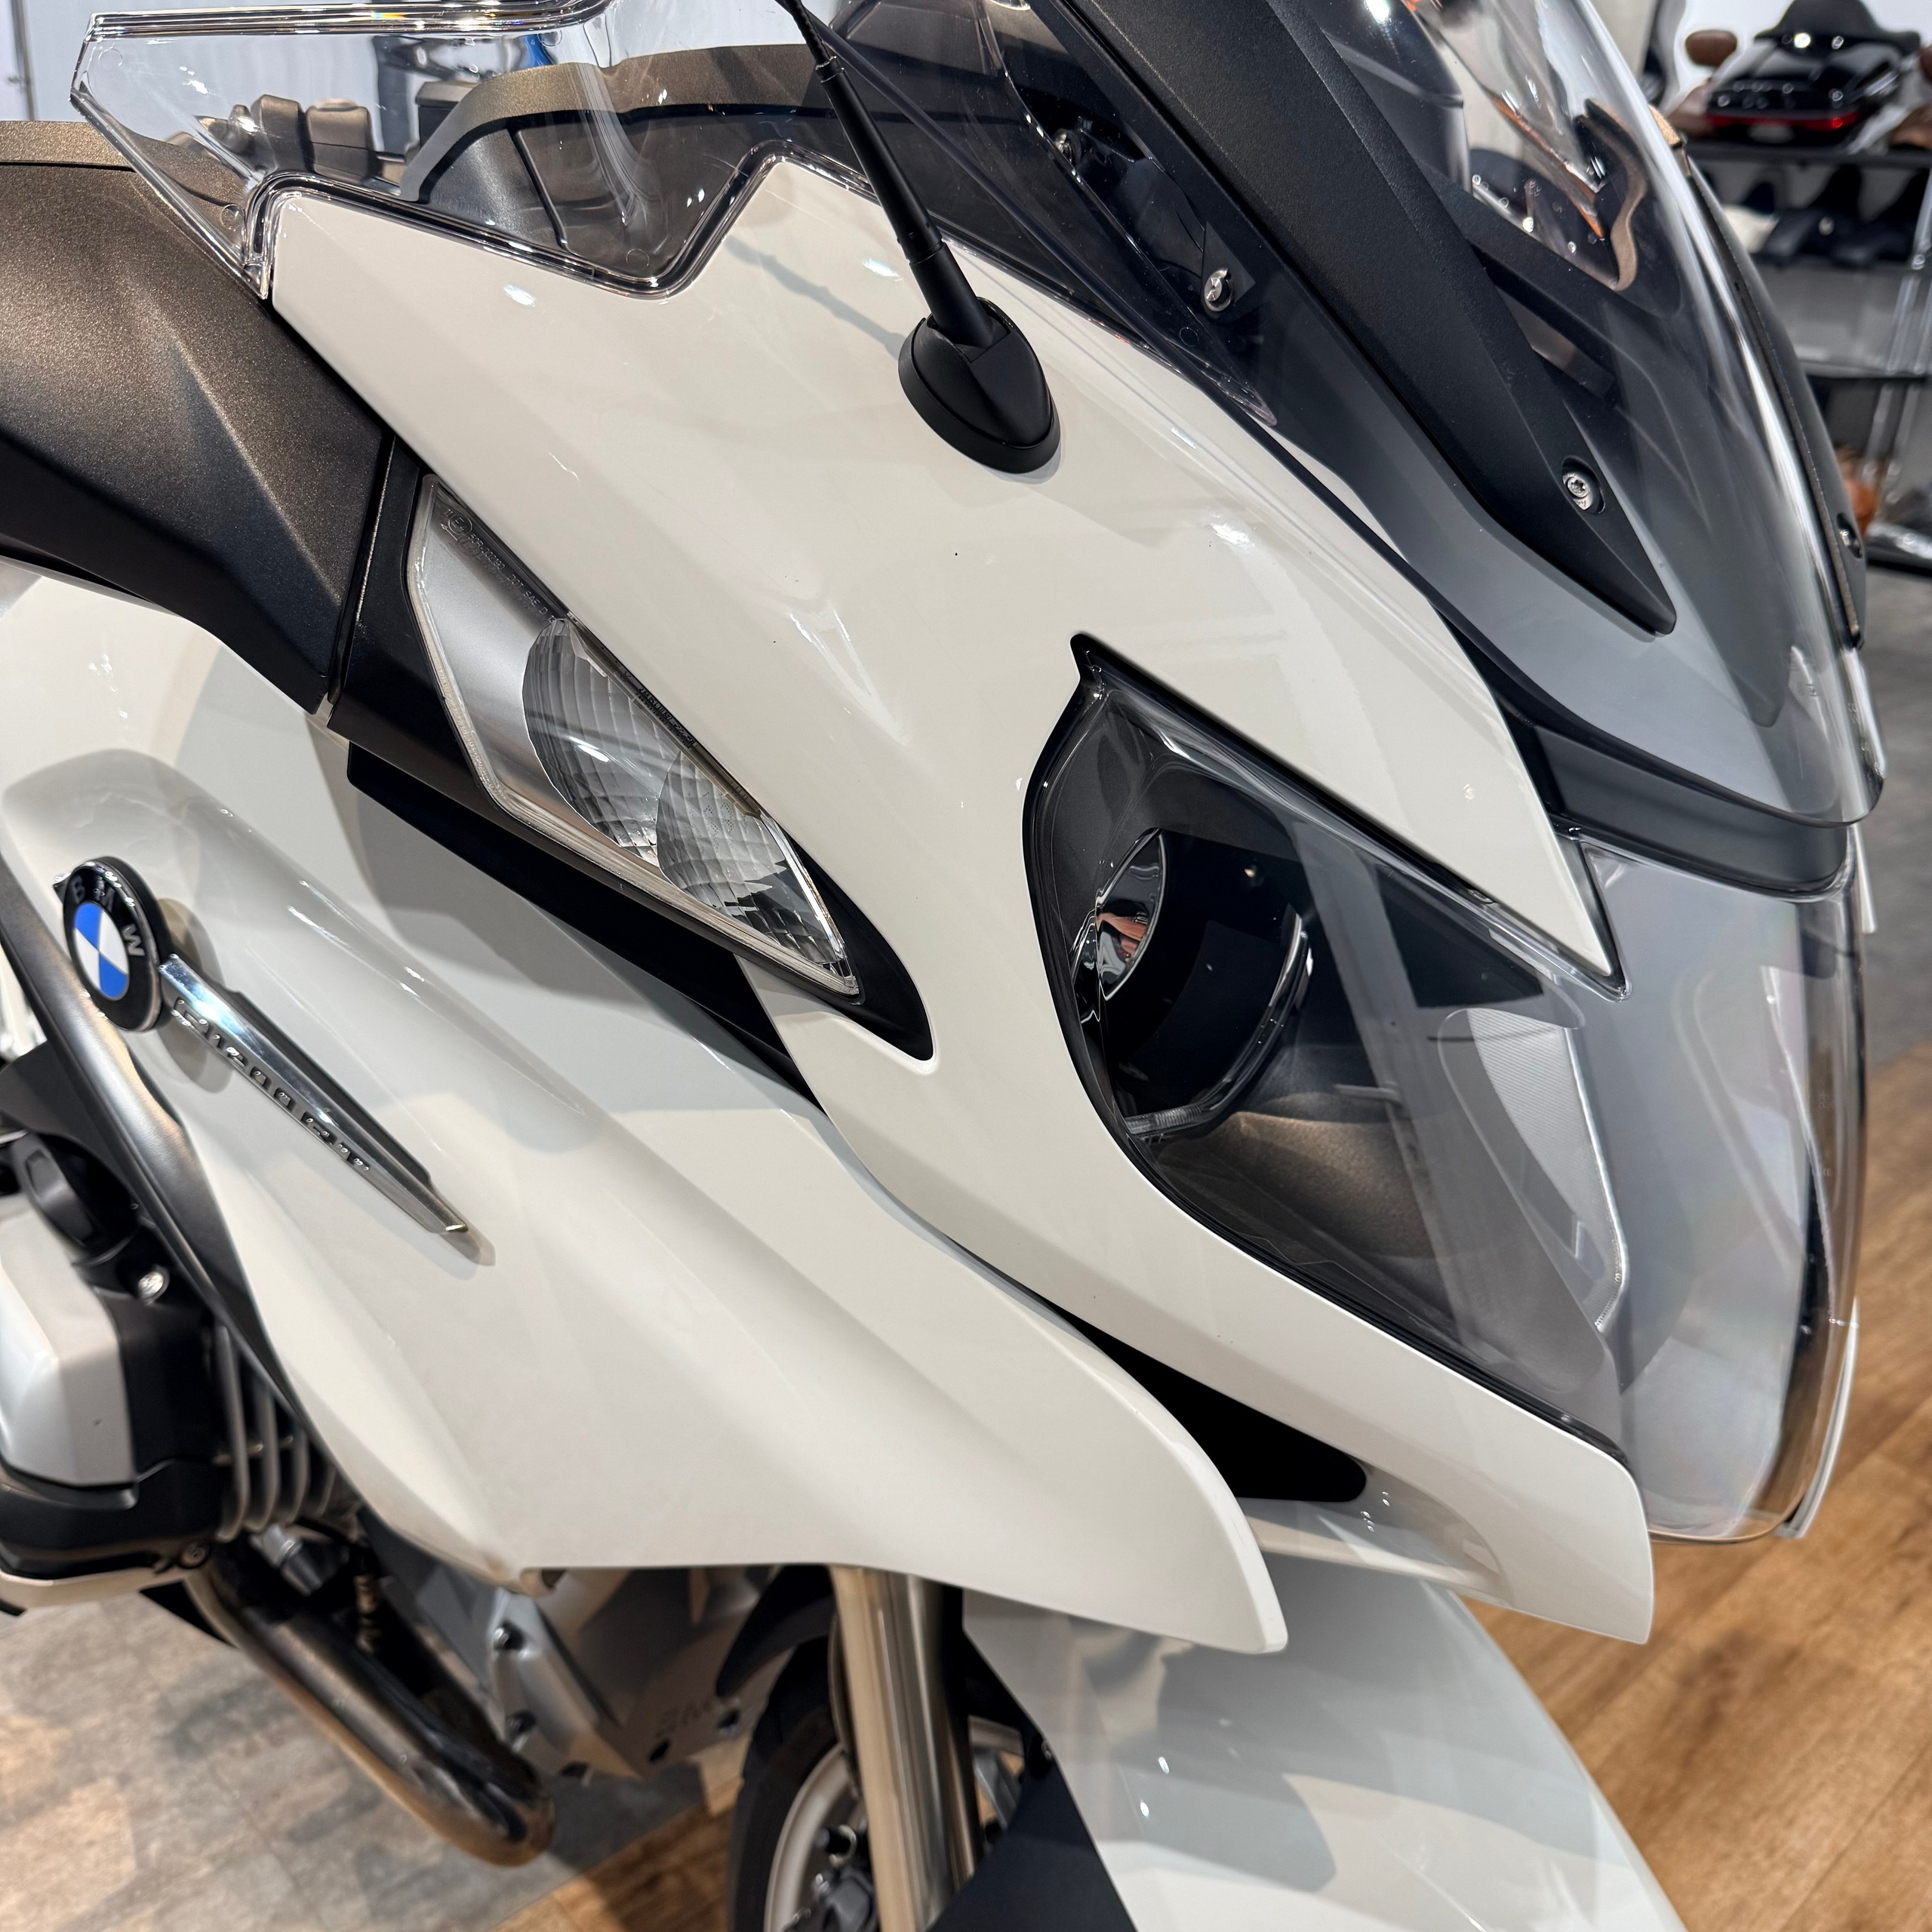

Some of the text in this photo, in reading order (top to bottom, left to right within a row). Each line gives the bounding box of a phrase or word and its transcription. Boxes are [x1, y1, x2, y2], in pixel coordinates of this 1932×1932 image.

[507, 574, 525, 588] DOT
[524, 591, 541, 607] SAE
[69, 873, 146, 956] BMW
